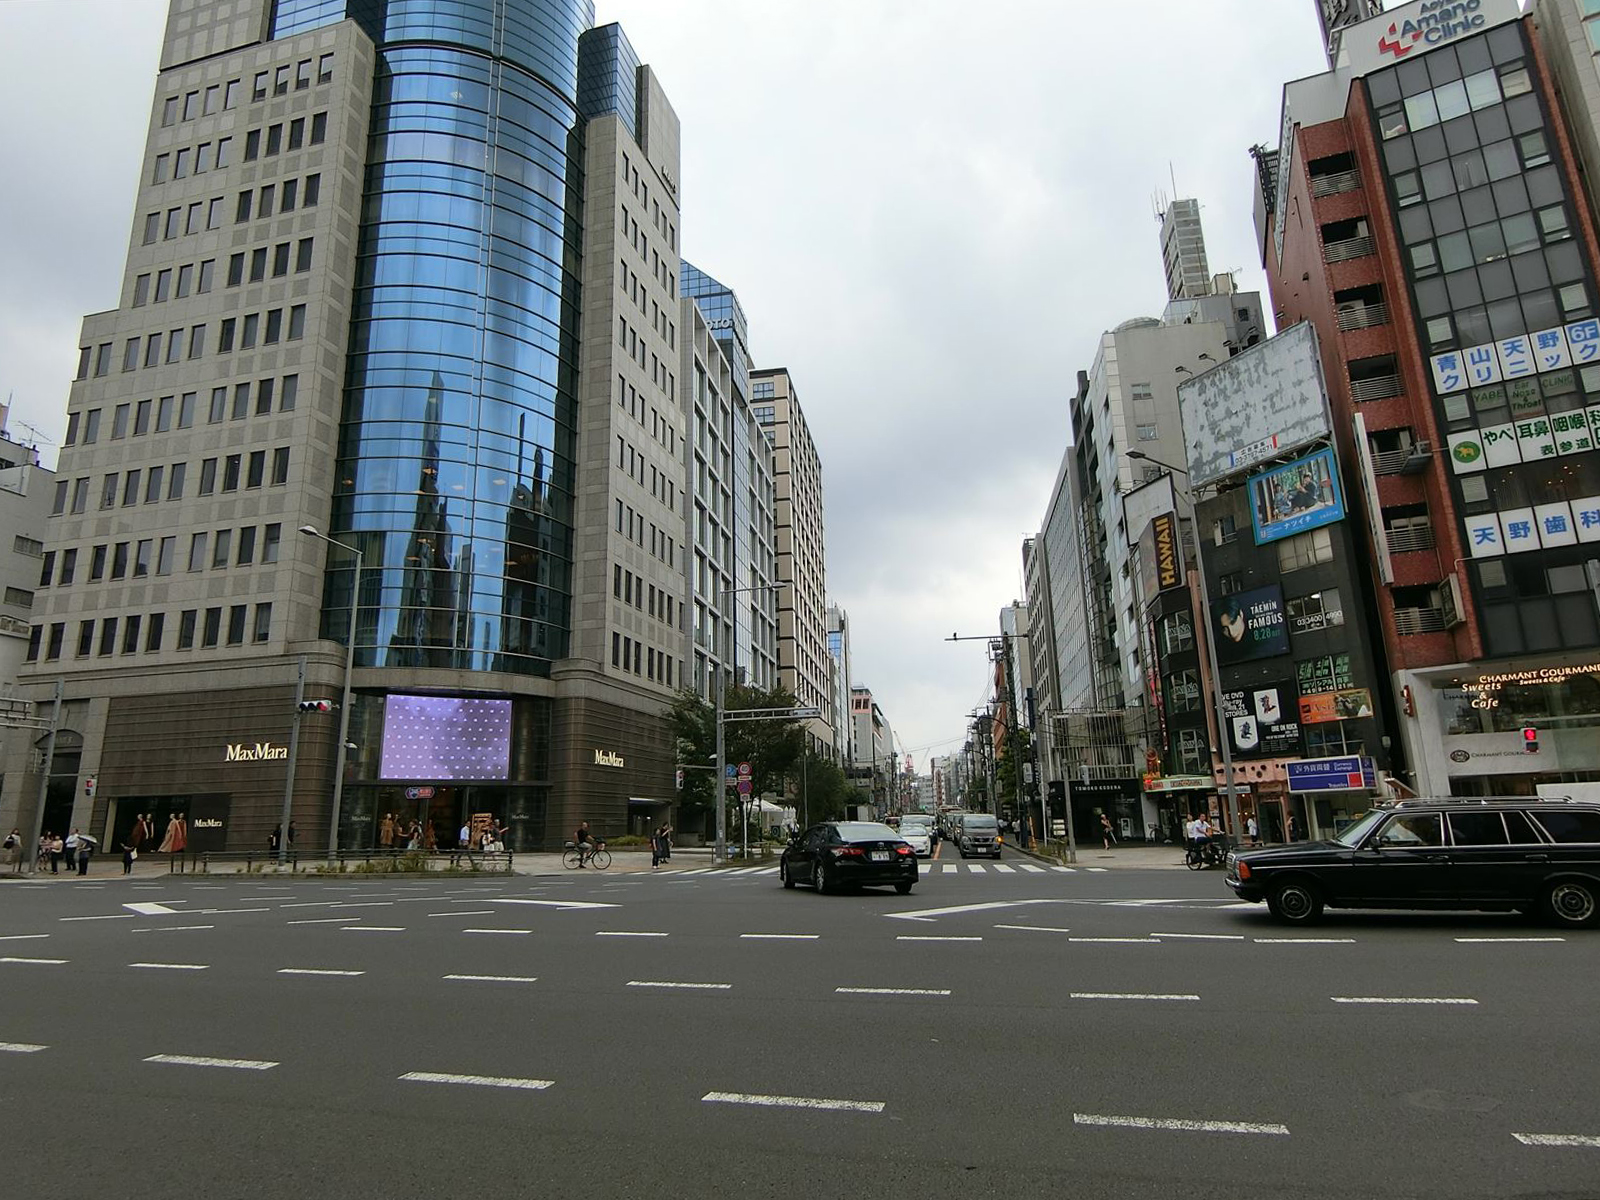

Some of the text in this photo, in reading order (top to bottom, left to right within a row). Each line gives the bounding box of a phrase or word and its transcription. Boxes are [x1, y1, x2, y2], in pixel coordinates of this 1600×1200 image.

[1401, 0, 1480, 38] Amano
[1424, 14, 1485, 43] Clinic
[1571, 324, 1597, 342] 6F
[1437, 331, 1559, 373] 青山天野
[1442, 343, 1597, 391] クリニック
[1156, 517, 1175, 586] HAWAII
[1461, 682, 1501, 692] Sweets
[1471, 698, 1499, 710] Cafe
[224, 742, 287, 761] MaxMara
[594, 749, 624, 767] MaxMara
[194, 819, 222, 827] MaxMara
